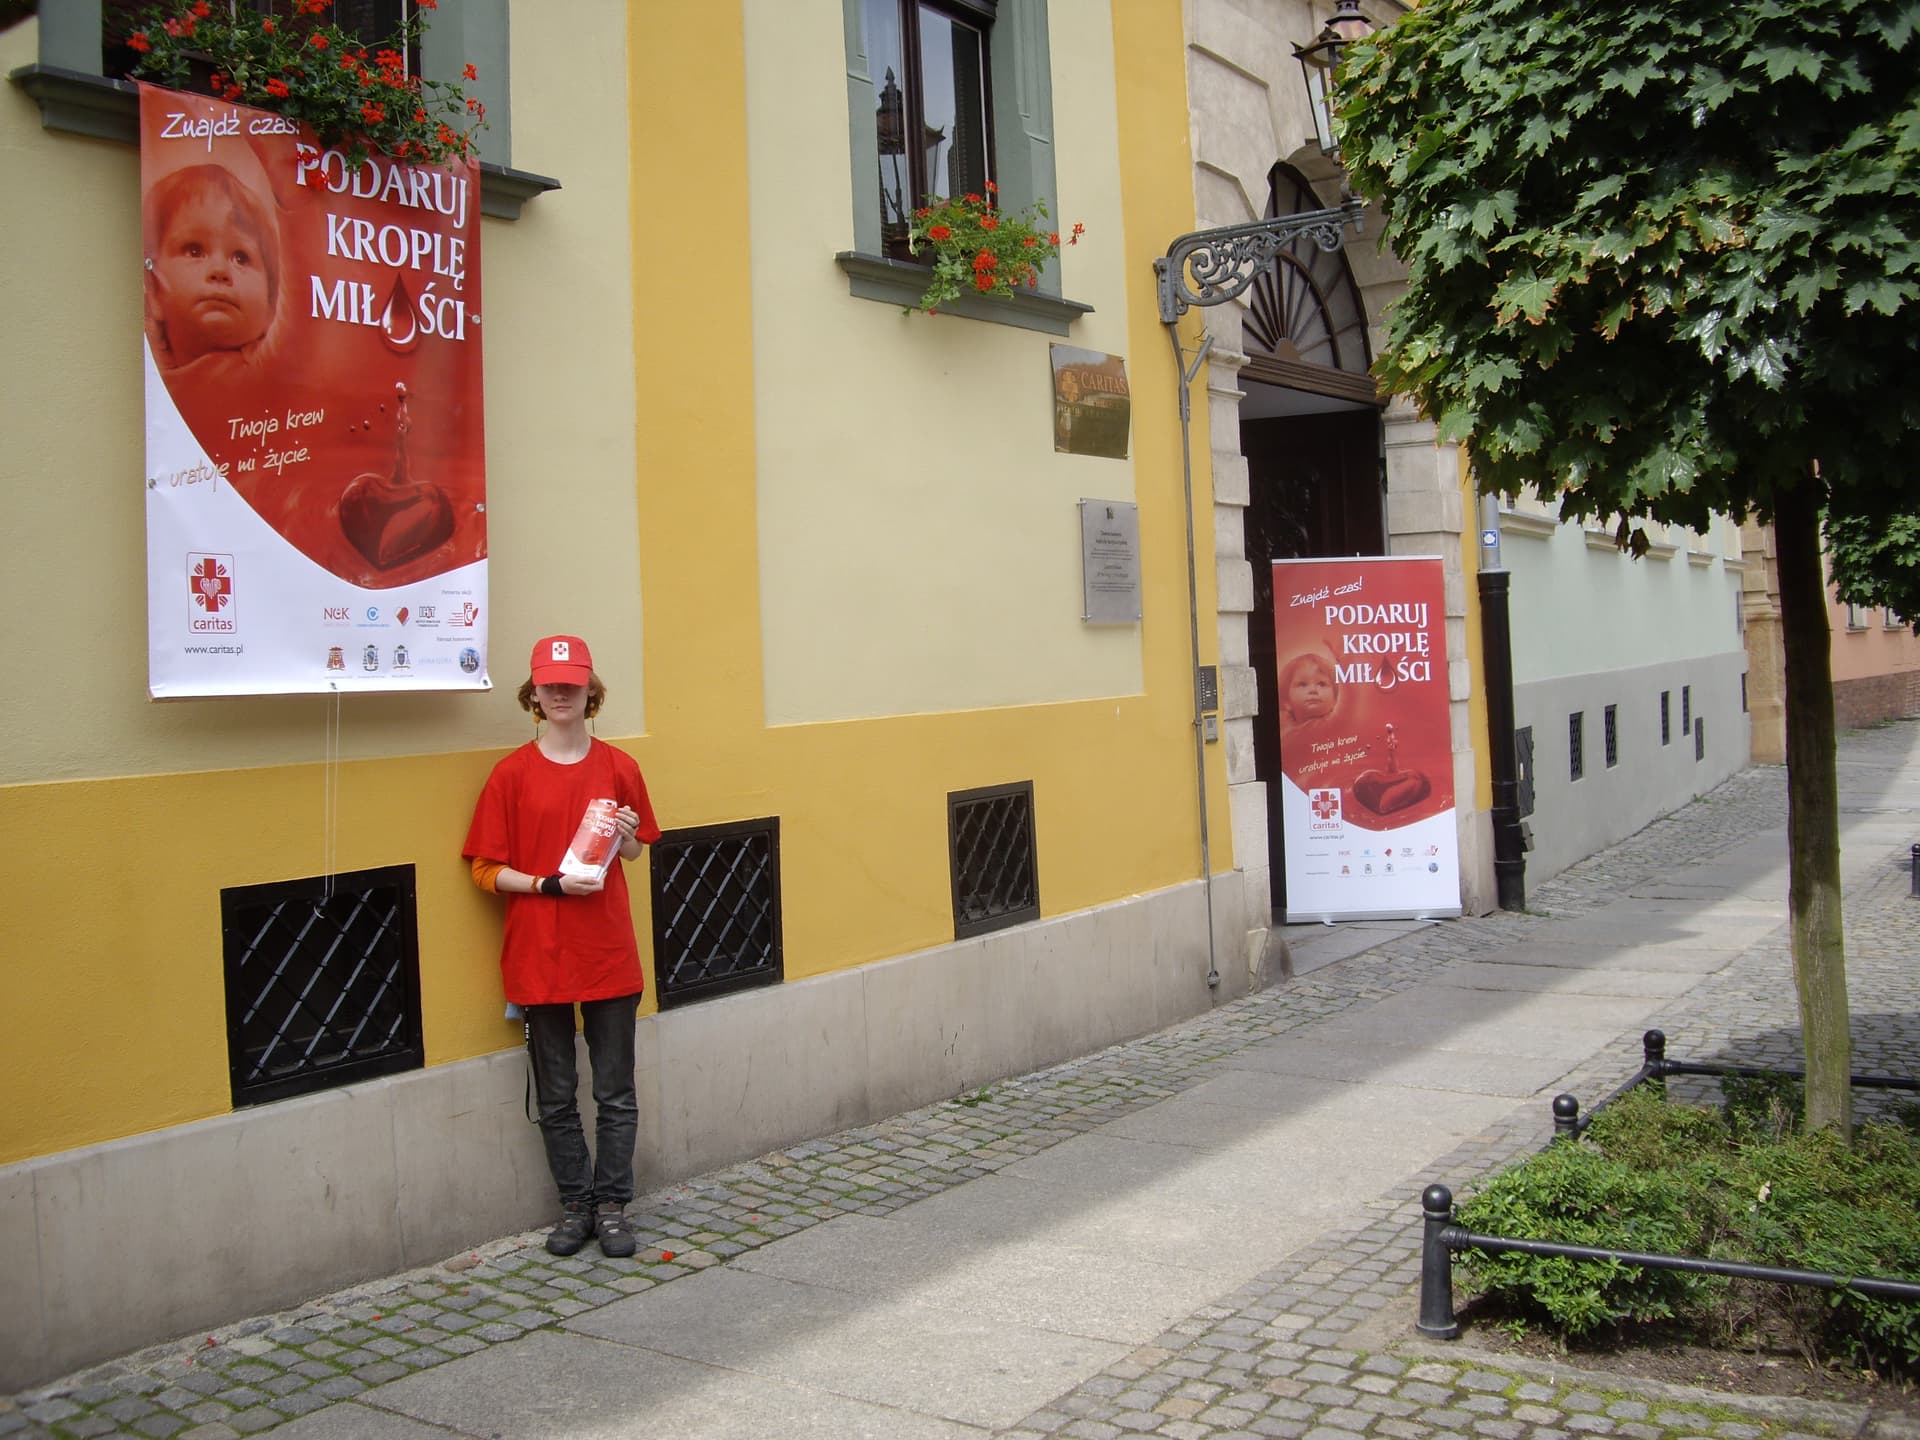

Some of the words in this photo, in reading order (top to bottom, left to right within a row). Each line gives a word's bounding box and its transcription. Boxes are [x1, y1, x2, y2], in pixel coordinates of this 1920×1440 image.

[161, 107, 241, 152] Znajdź
[296, 143, 467, 229] PODARUJ
[327, 213, 465, 290] KROPLĘ
[1081, 371, 1127, 394] CARITAS
[228, 409, 279, 447] Twoja
[286, 408, 325, 430] krew
[169, 453, 230, 493] uratuje
[237, 448, 257, 473] mi
[262, 440, 312, 476] życie.
[1290, 585, 1330, 609] Znajdź
[1333, 575, 1363, 596] czas!
[193, 616, 233, 630] caritas
[1324, 602, 1428, 629] PODARUJ
[184, 643, 244, 657] www.caritas.pl
[1342, 631, 1430, 657] KROPLĘ
[1311, 739, 1335, 755] Twoja
[1312, 822, 1340, 830] caritas
